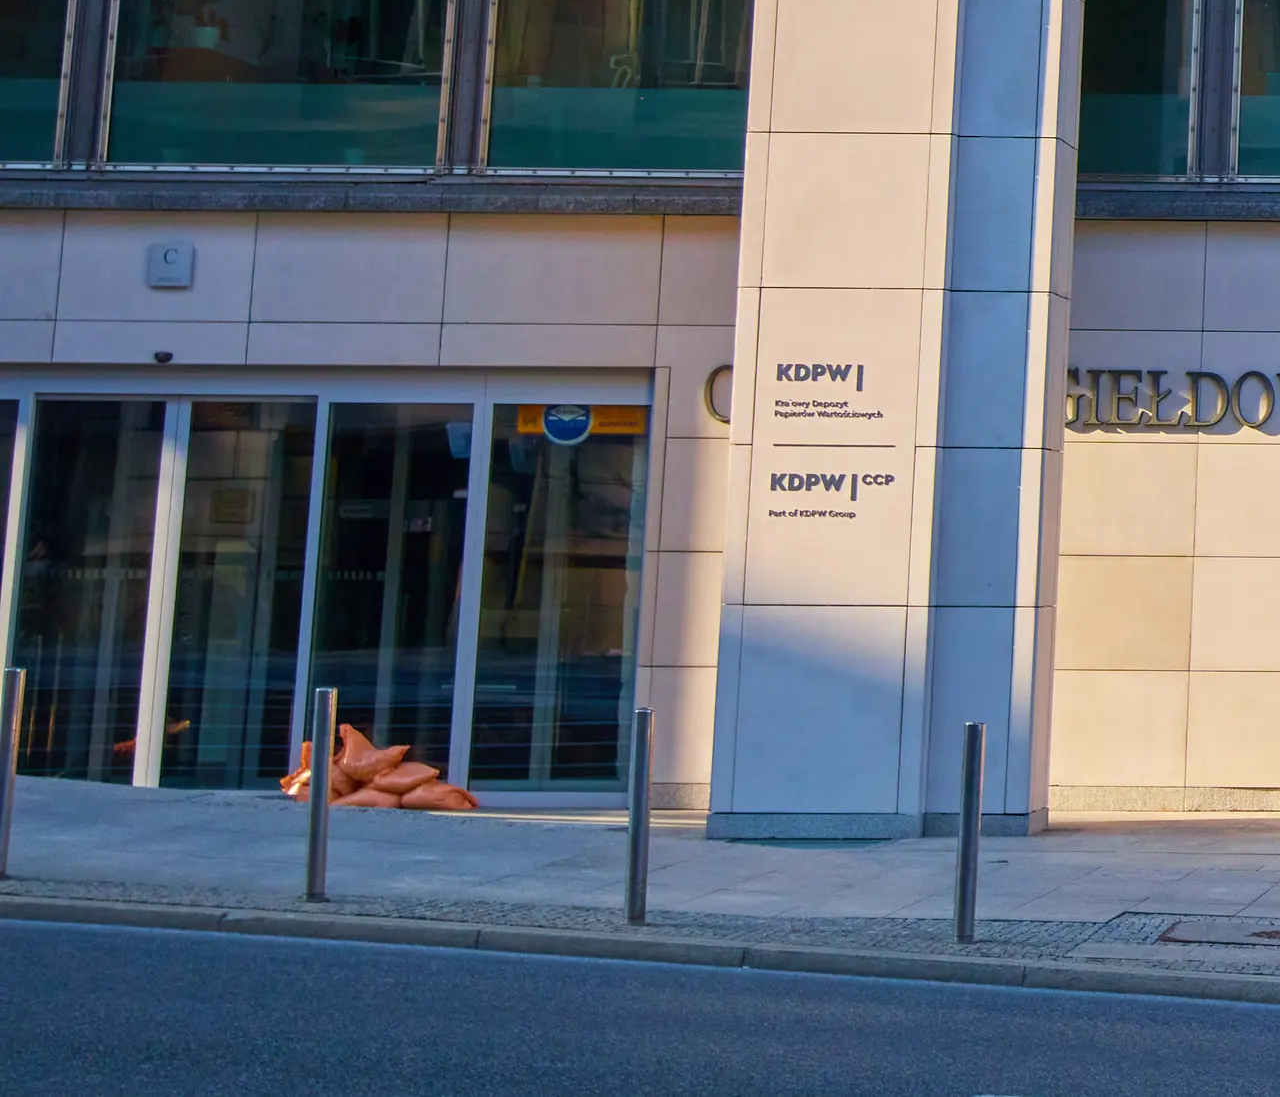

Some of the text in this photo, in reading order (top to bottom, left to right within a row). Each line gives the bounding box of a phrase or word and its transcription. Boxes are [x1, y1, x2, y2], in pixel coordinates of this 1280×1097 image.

[163, 248, 178, 265] C
[776, 363, 853, 382] KDPW
[774, 399, 850, 410] Kraowy Depozyt
[770, 473, 896, 492] KDPW CCP
[768, 509, 787, 518] Part
[799, 509, 828, 518] KDPW
[828, 510, 857, 520] Group
